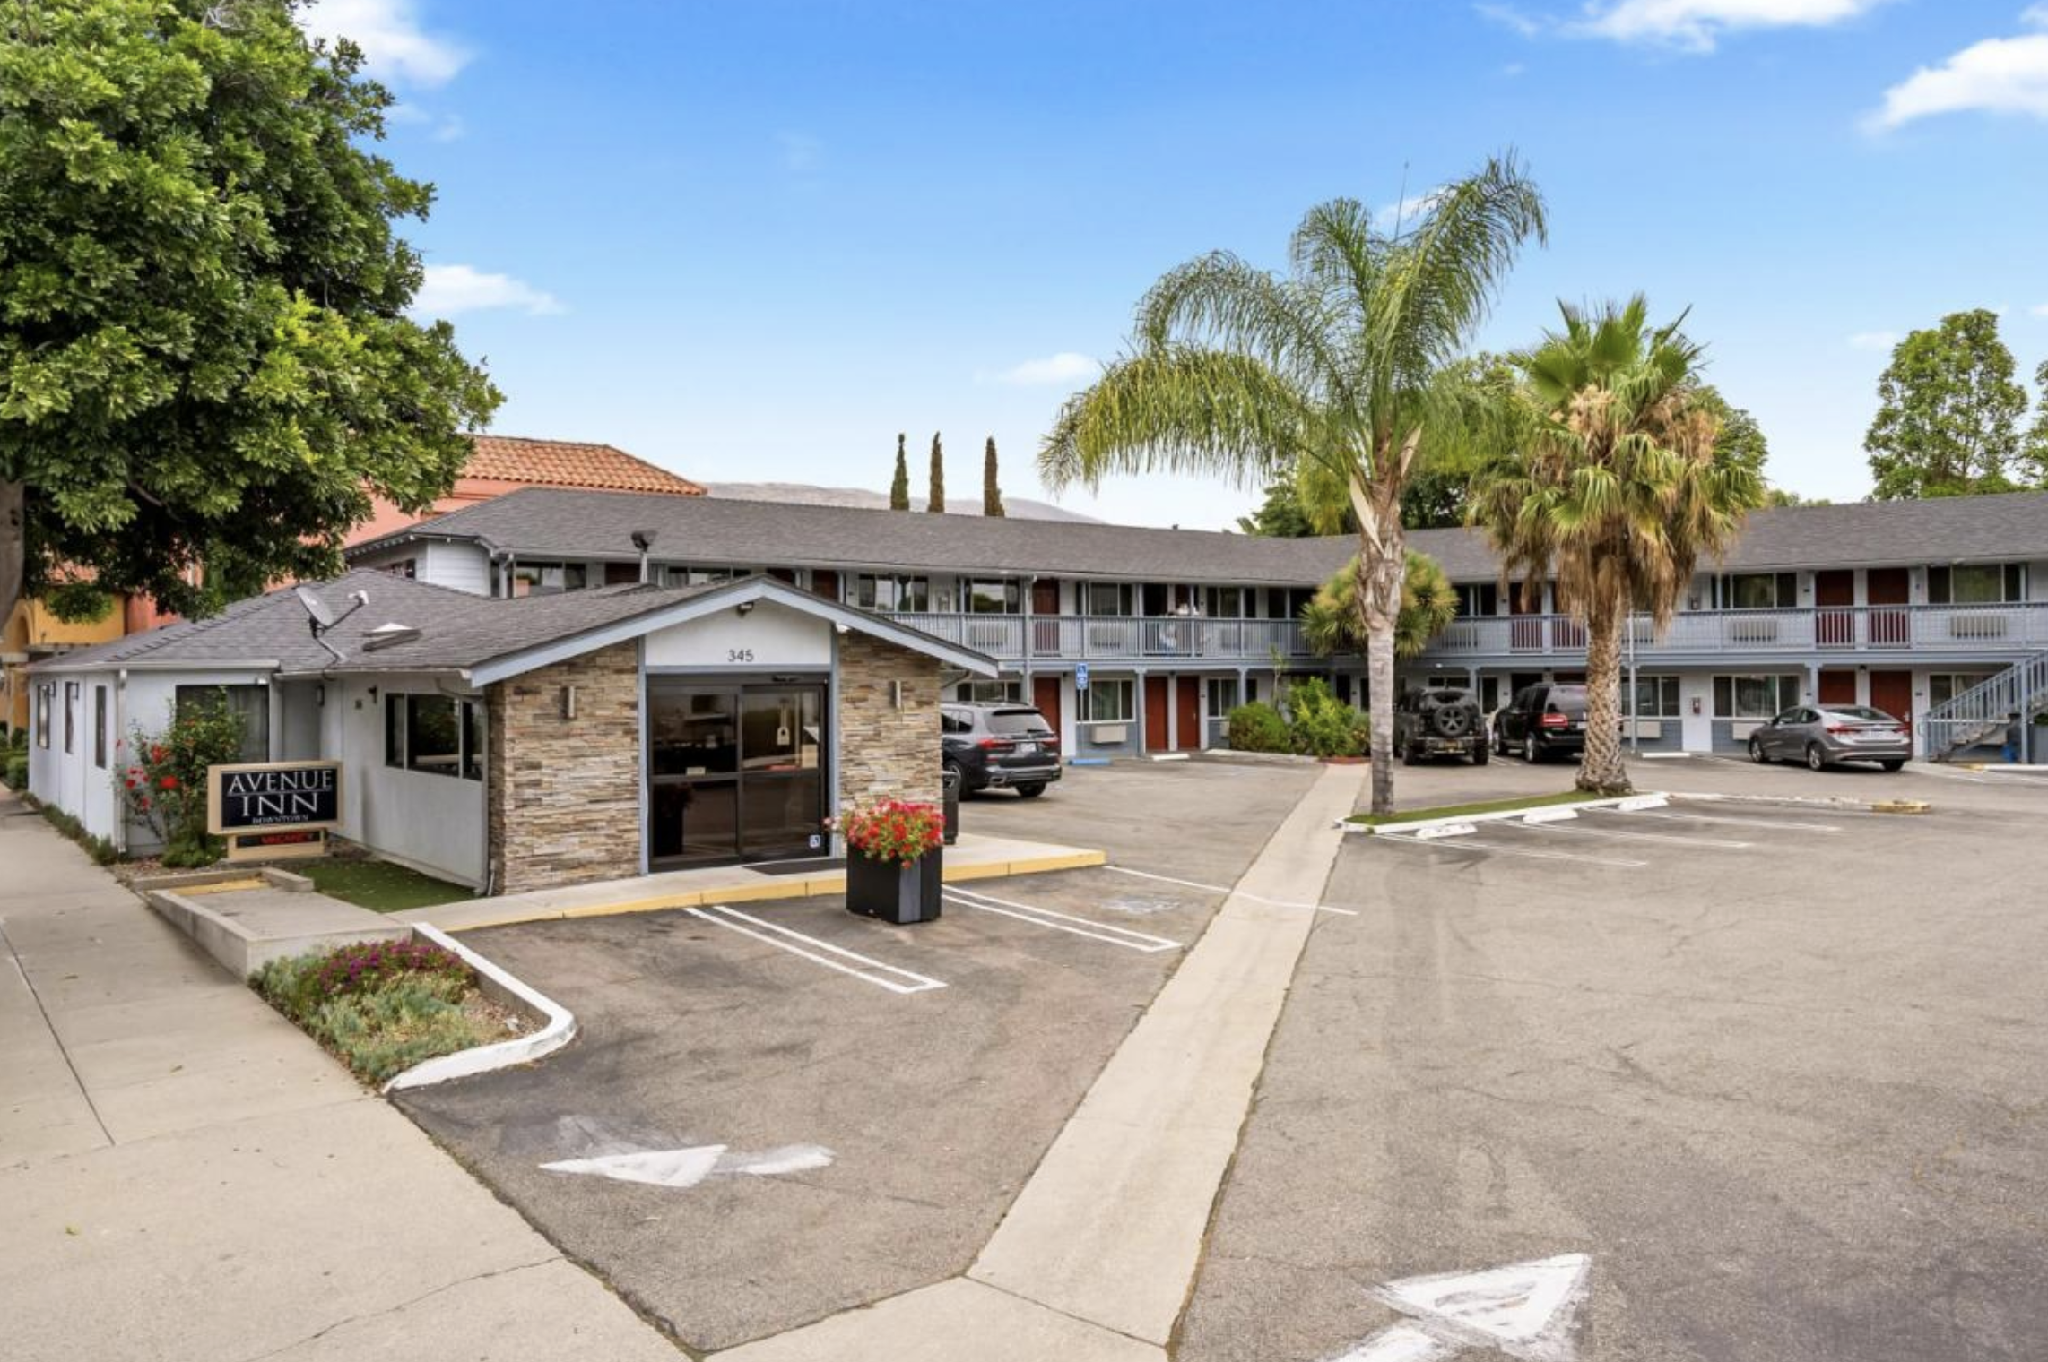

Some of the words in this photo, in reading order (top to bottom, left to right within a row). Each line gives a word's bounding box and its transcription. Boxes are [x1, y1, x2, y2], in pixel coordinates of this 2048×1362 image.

[728, 649, 754, 662] 345
[229, 770, 333, 793] AVENUE
[242, 792, 318, 817] INN
